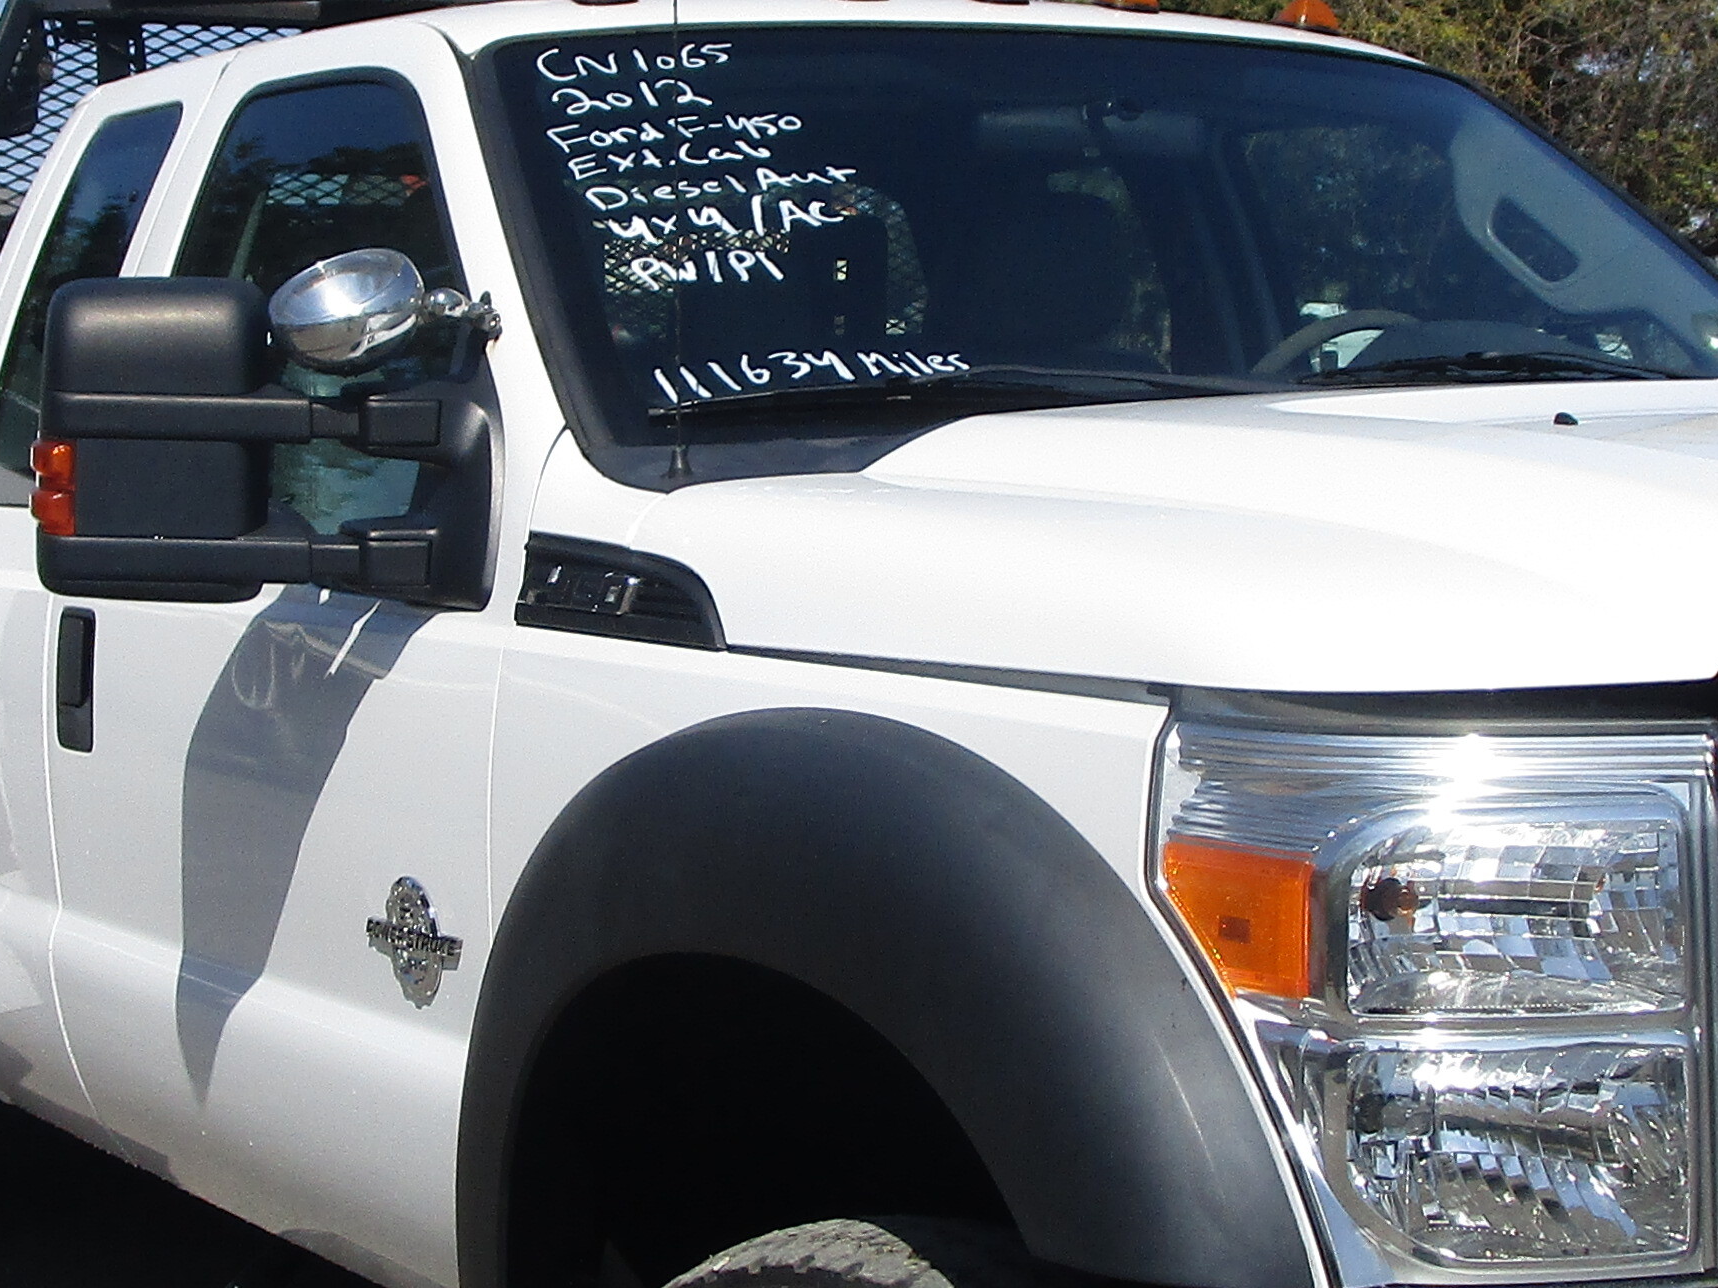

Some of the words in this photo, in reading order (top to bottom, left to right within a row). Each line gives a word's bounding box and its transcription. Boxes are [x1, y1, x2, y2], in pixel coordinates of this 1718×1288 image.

[552, 79, 713, 115] 2012
[547, 122, 664, 153] Ford
[667, 114, 802, 139] F-450
[585, 174, 746, 210] Diesel
[654, 351, 856, 404] 111634
